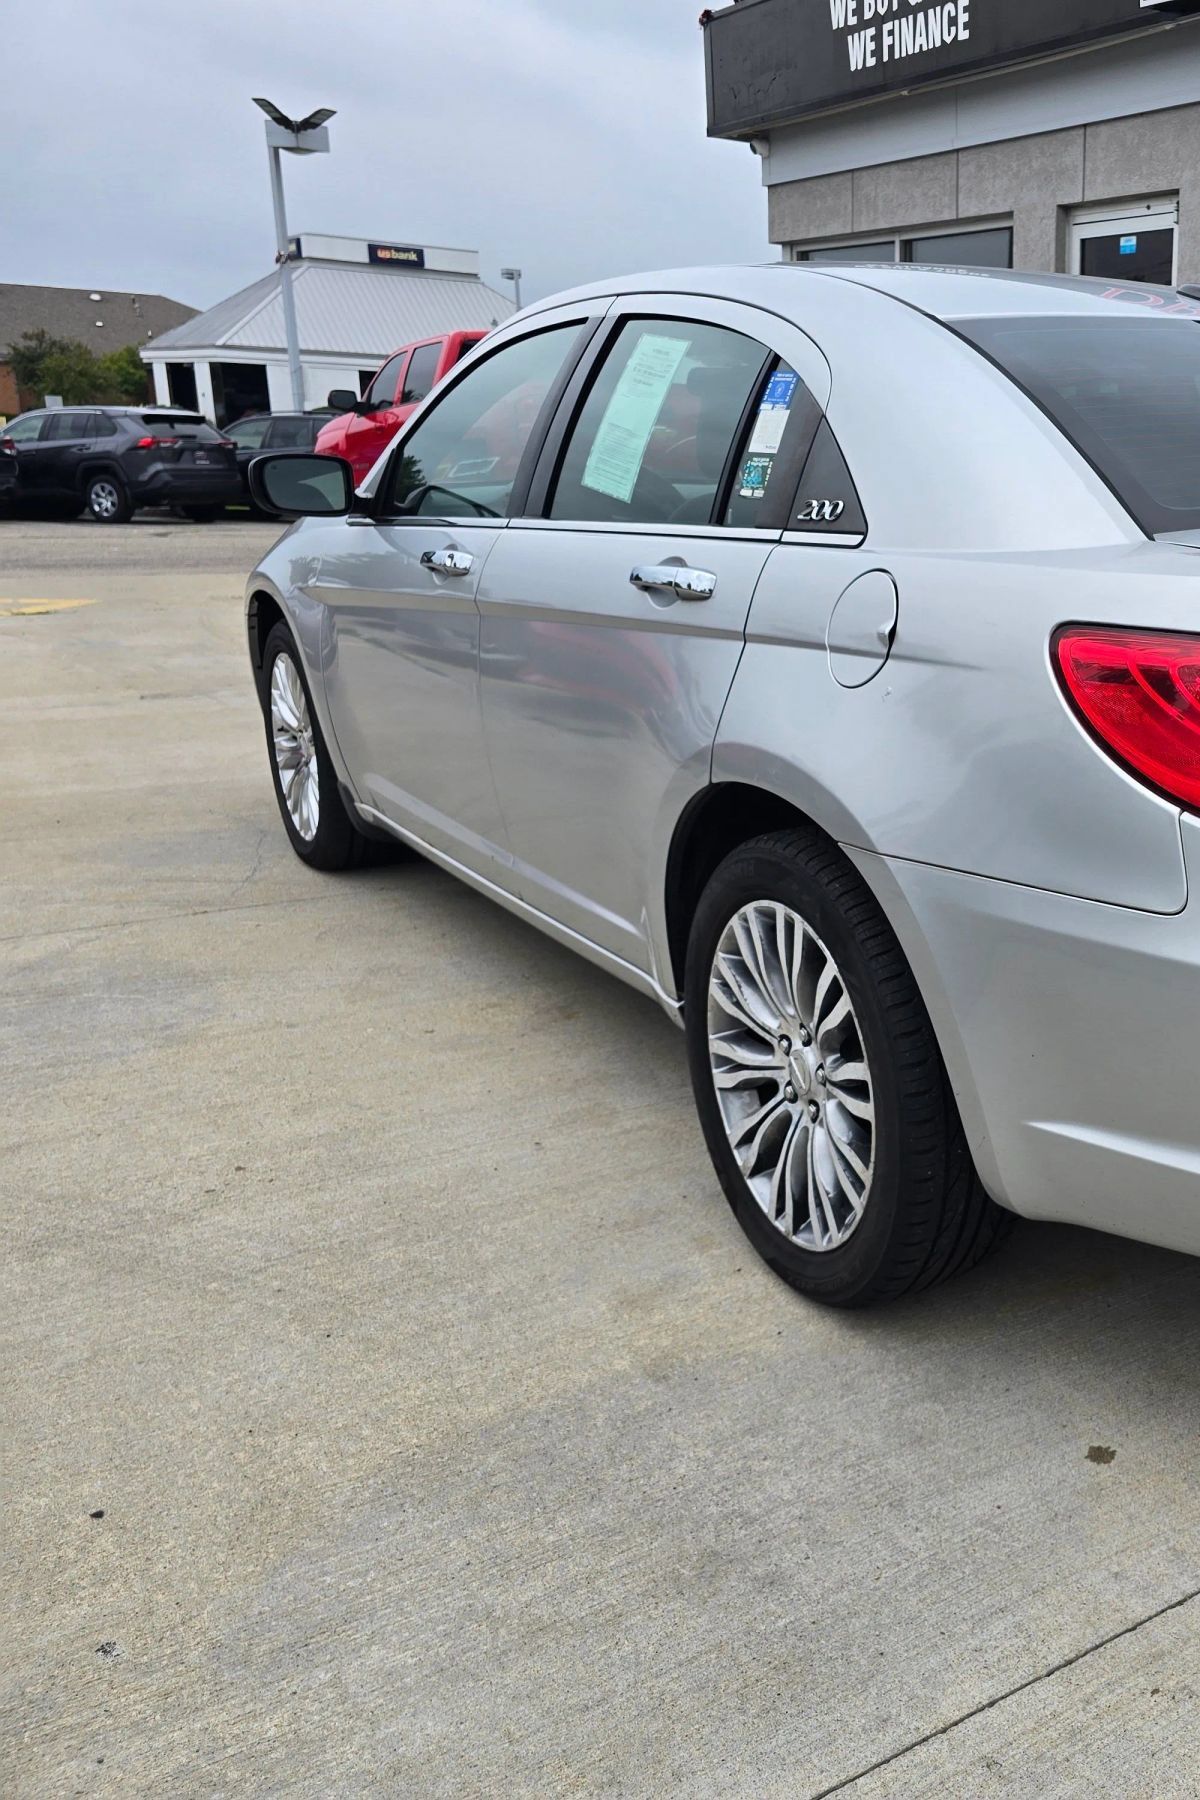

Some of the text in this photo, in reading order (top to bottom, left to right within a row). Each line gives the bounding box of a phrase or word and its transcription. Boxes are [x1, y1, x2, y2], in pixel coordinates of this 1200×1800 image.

[847, 0, 970, 72] WE FINANCE
[797, 499, 845, 521] 200
